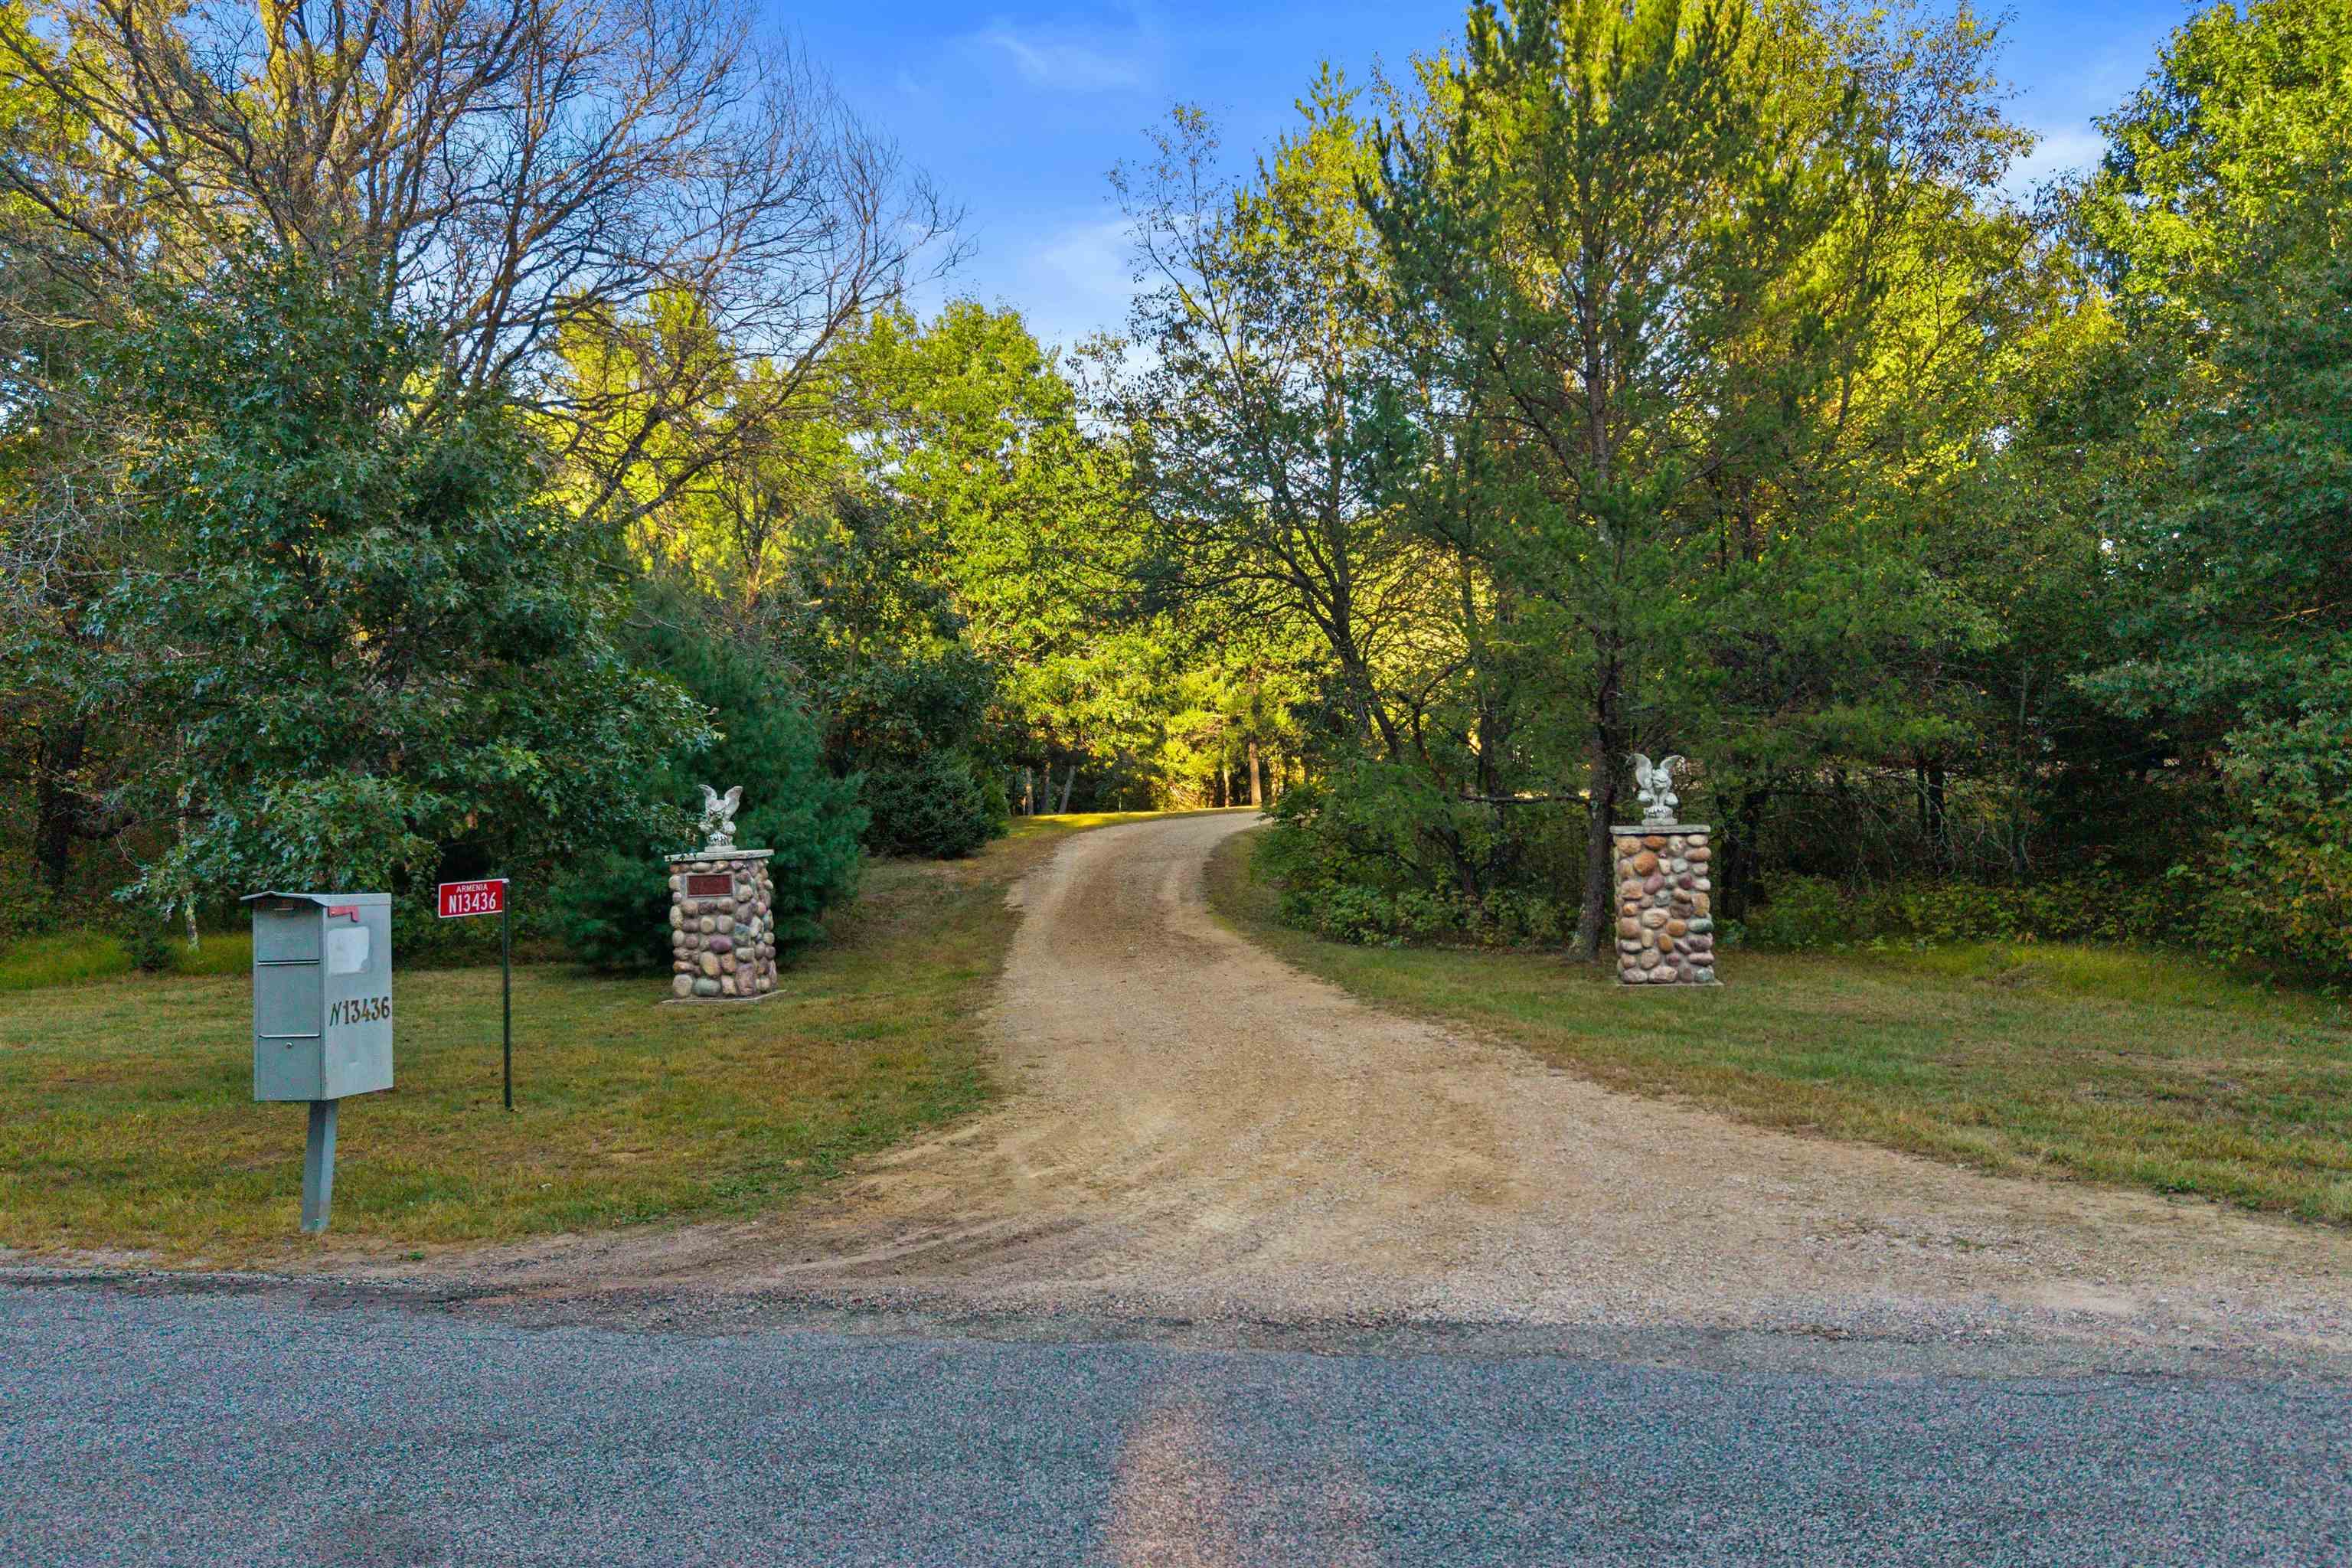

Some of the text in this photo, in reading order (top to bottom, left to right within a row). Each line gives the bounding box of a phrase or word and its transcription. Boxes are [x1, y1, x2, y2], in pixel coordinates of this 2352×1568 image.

[456, 884, 488, 893] ARMENIA
[449, 892, 496, 913] N13436
[329, 997, 390, 1026] N13436
